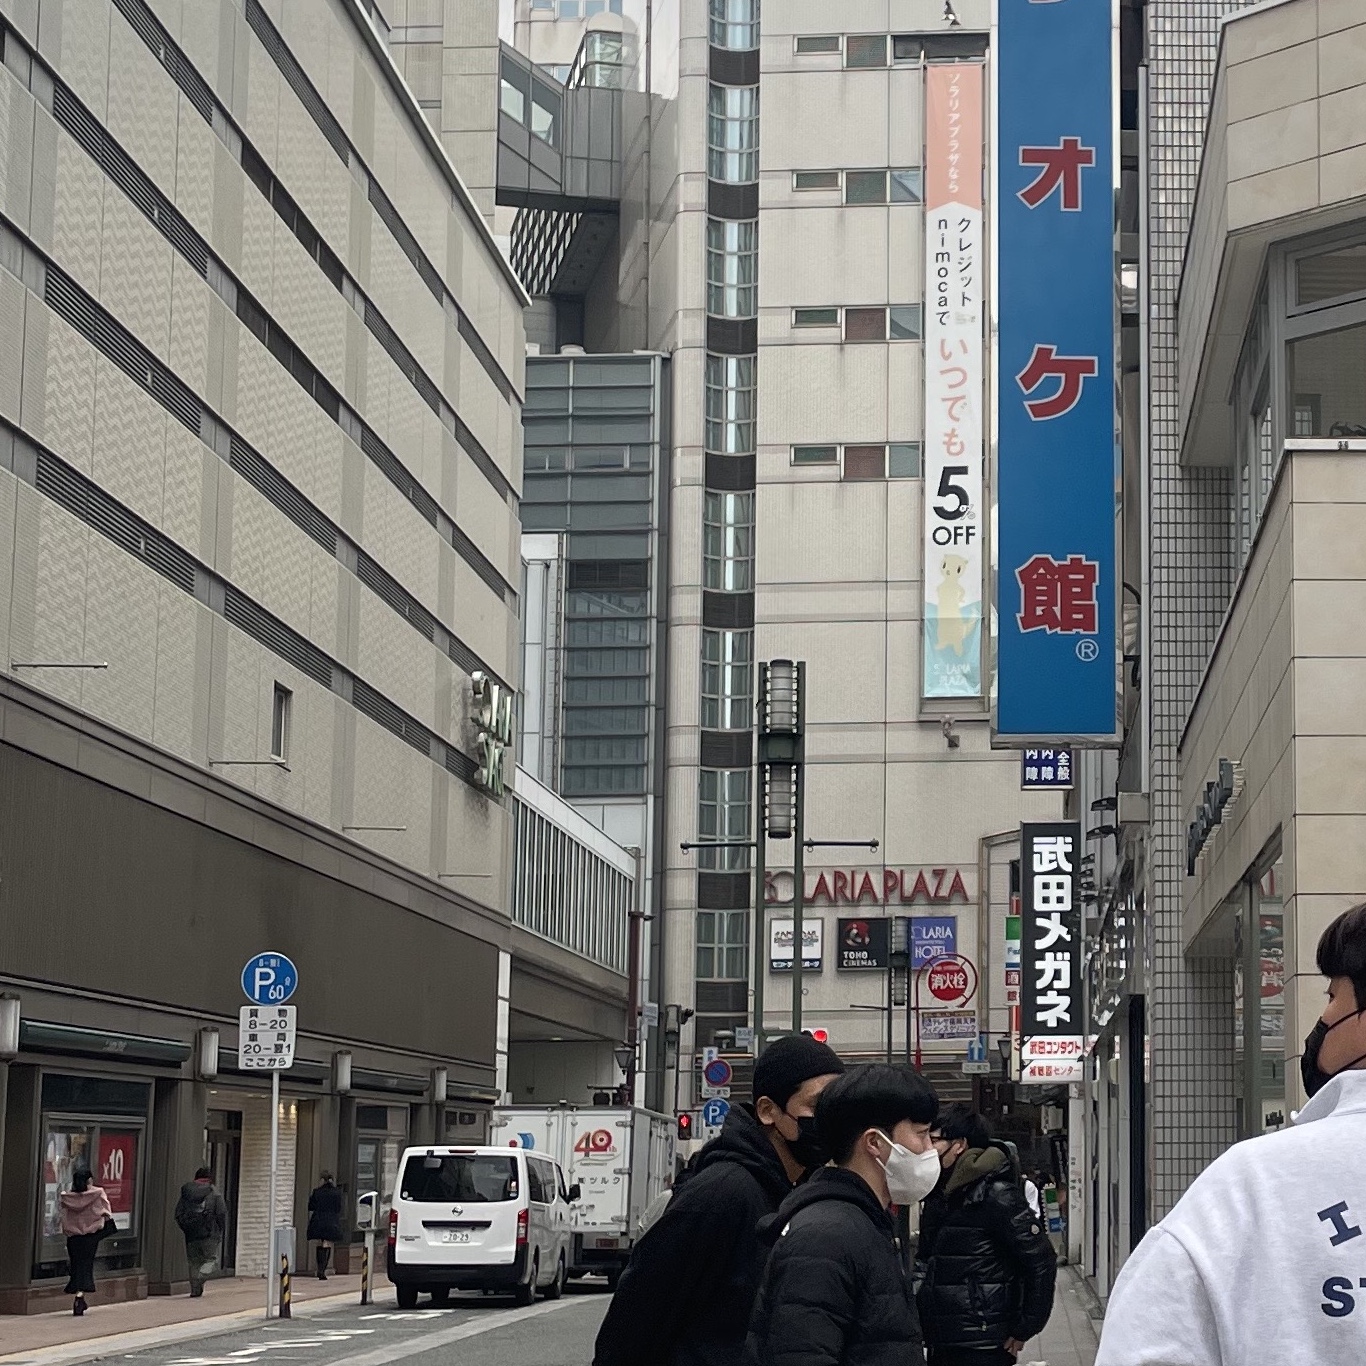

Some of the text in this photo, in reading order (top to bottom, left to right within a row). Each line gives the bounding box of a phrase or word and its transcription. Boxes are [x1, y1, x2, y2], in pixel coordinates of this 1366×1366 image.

[957, 217, 972, 307] クレジット
[1016, 0, 1100, 636] オケ館
[939, 338, 969, 457] いつでも
[932, 526, 976, 545] OFF
[884, 869, 969, 902] PLAZA
[1033, 836, 1073, 1028] 武田メガネ
[843, 951, 867, 959] TOHO
[843, 959, 877, 967] CINEMAS
[254, 968, 275, 999] P
[931, 973, 966, 990] 消火栓
[1030, 1041, 1081, 1054] 武田コンタクト
[245, 1058, 287, 1067] ここから
